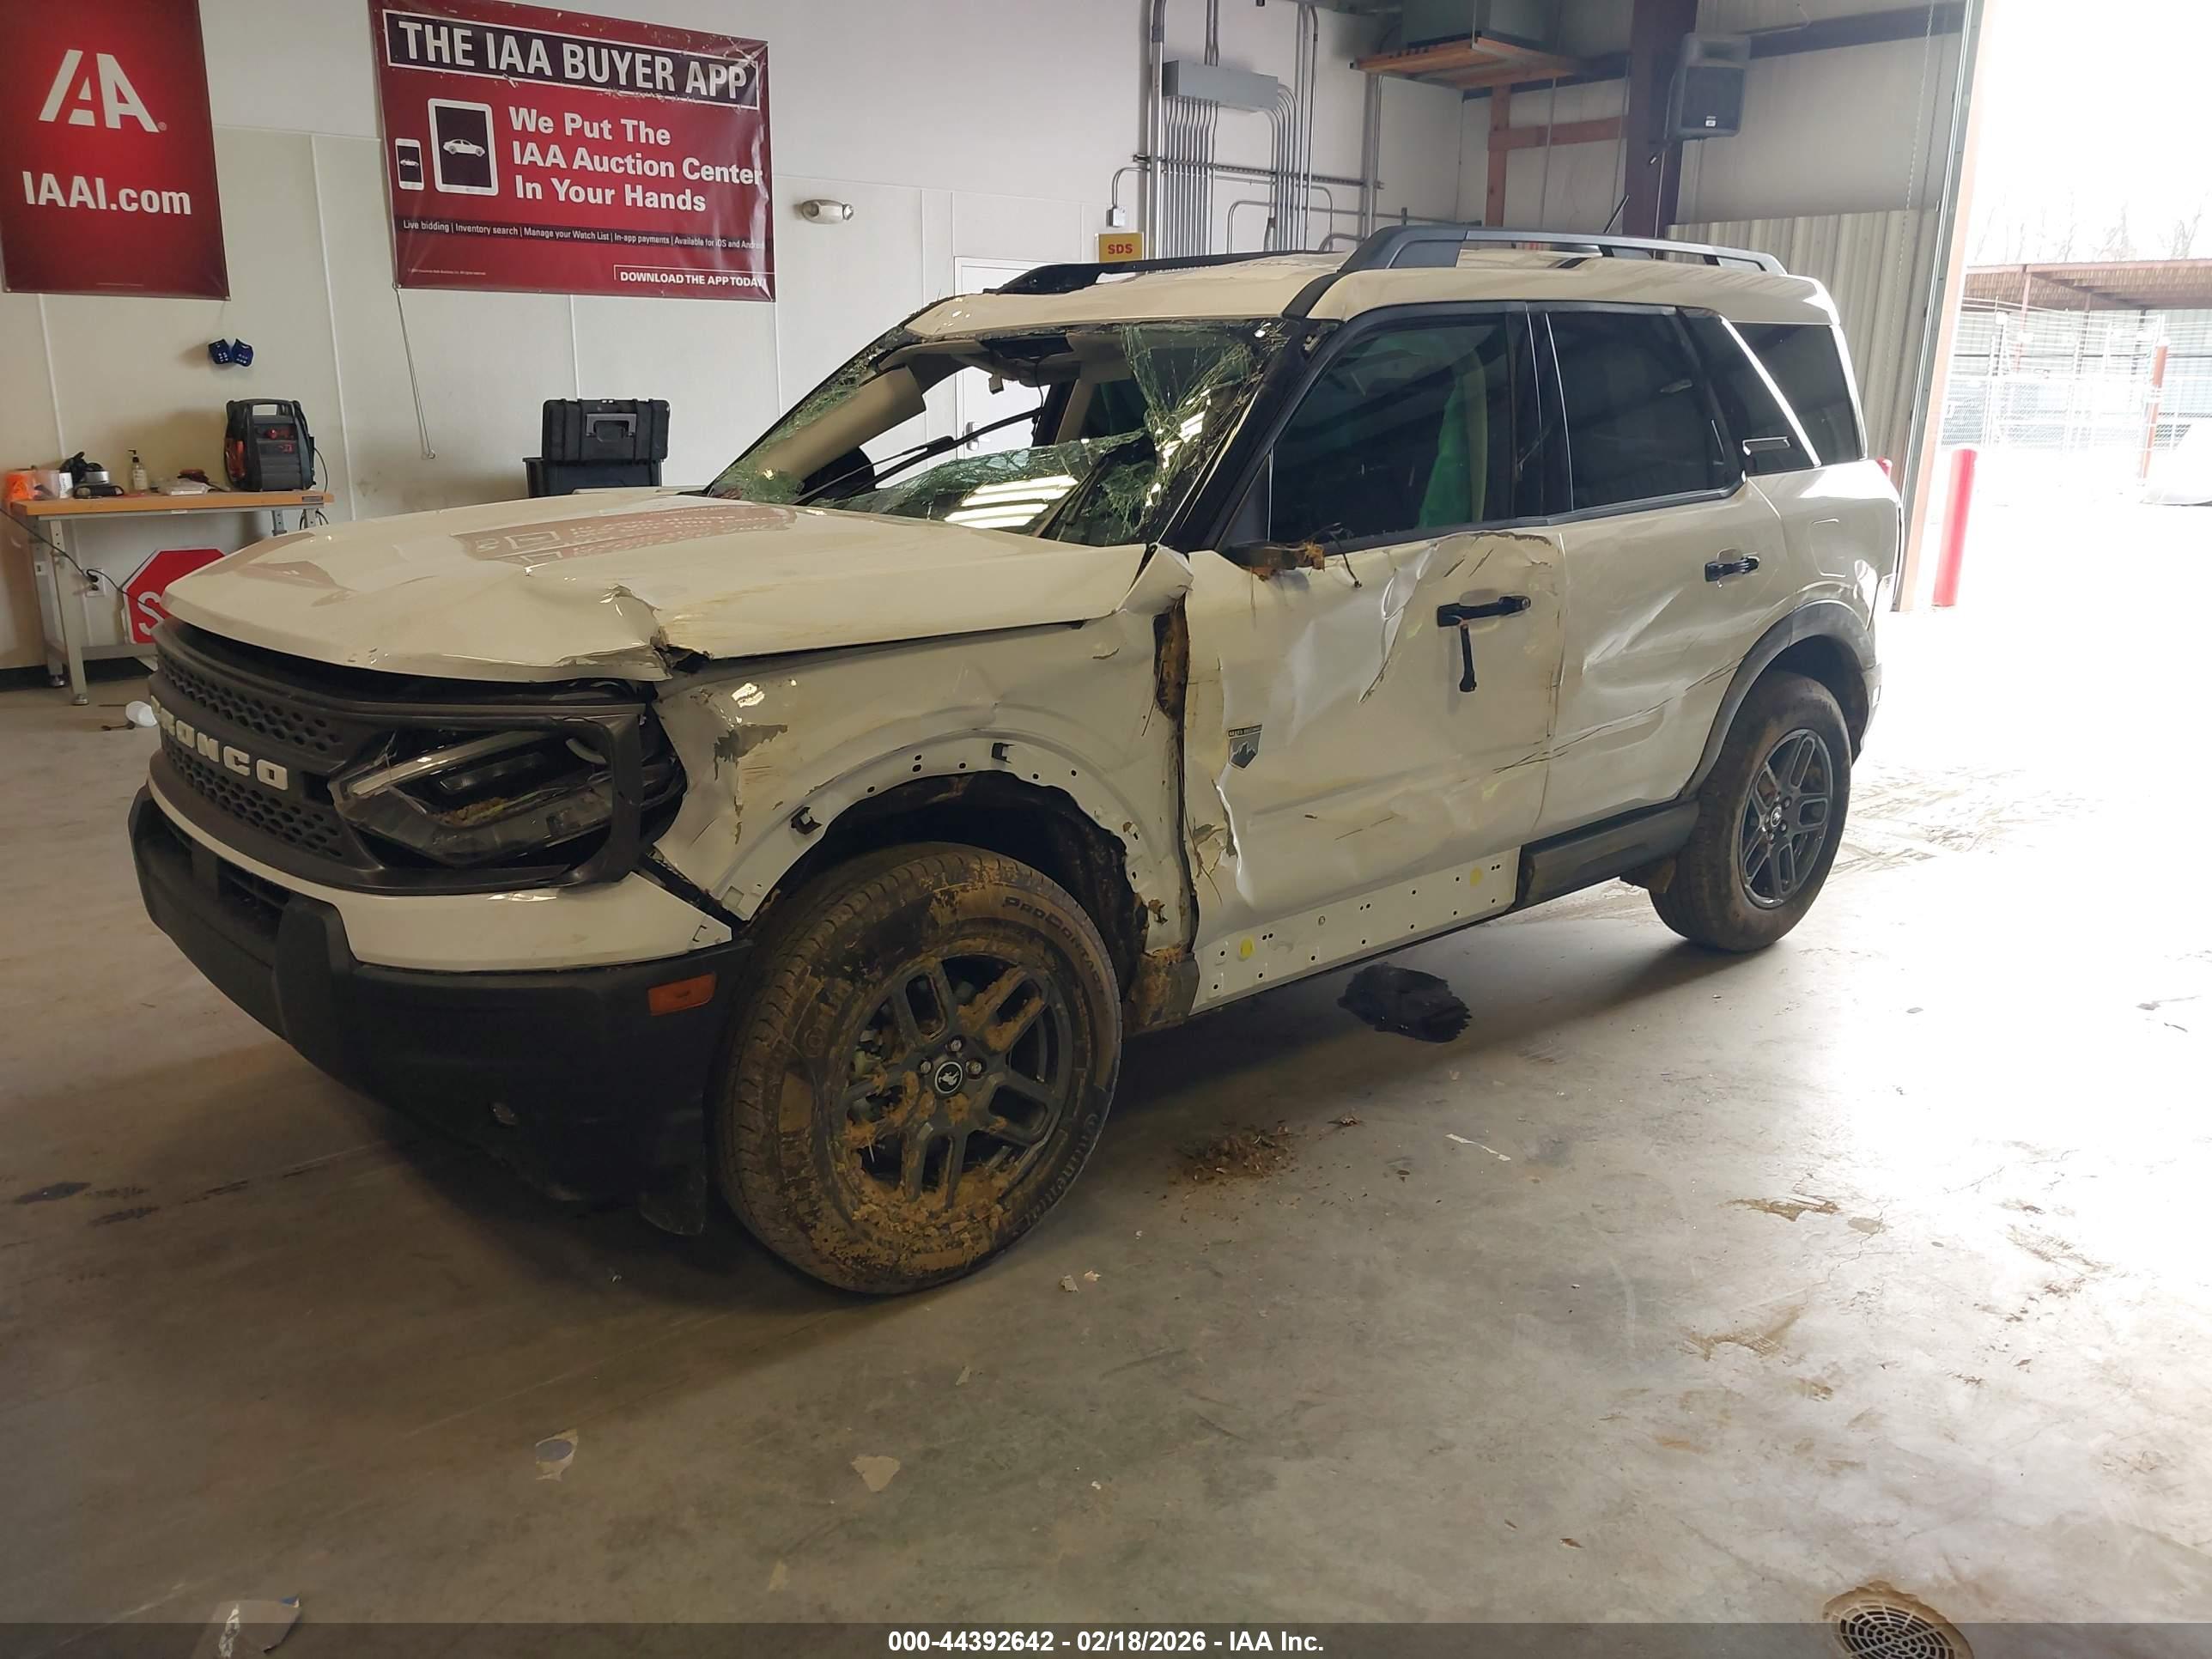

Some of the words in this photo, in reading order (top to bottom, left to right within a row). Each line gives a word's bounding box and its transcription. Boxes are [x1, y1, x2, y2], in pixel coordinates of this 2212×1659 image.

[398, 21, 475, 66] THE
[486, 32, 552, 78] IAA
[562, 43, 676, 92] BUYER
[685, 61, 747, 100] APP
[508, 106, 554, 134] We
[563, 112, 612, 140] Put
[620, 118, 671, 146] The
[513, 140, 568, 169] IAA
[572, 147, 676, 179] Auction
[682, 157, 763, 185] Center
[22, 171, 192, 216] IAAI.com
[515, 175, 543, 200] In
[550, 178, 616, 205] Your
[624, 184, 707, 212] Hands
[403, 219, 419, 229] Live
[421, 221, 449, 233] bidding
[455, 223, 491, 235] Inventory
[492, 226, 518, 235] search
[524, 227, 554, 239] Manage
[555, 230, 571, 239] your
[572, 230, 596, 240] Watch
[597, 231, 610, 240] List
[614, 233, 636, 245] In-app
[637, 235, 670, 246] payments
[674, 236, 704, 246] Available
[705, 238, 714, 246] for
[715, 239, 727, 247] iOS
[727, 240, 740, 248] and
[740, 240, 765, 249] Andr
[1107, 243, 1133, 254] SDS
[619, 271, 684, 283] DOWNLOAD
[684, 274, 706, 285] THE
[707, 276, 729, 286] APP
